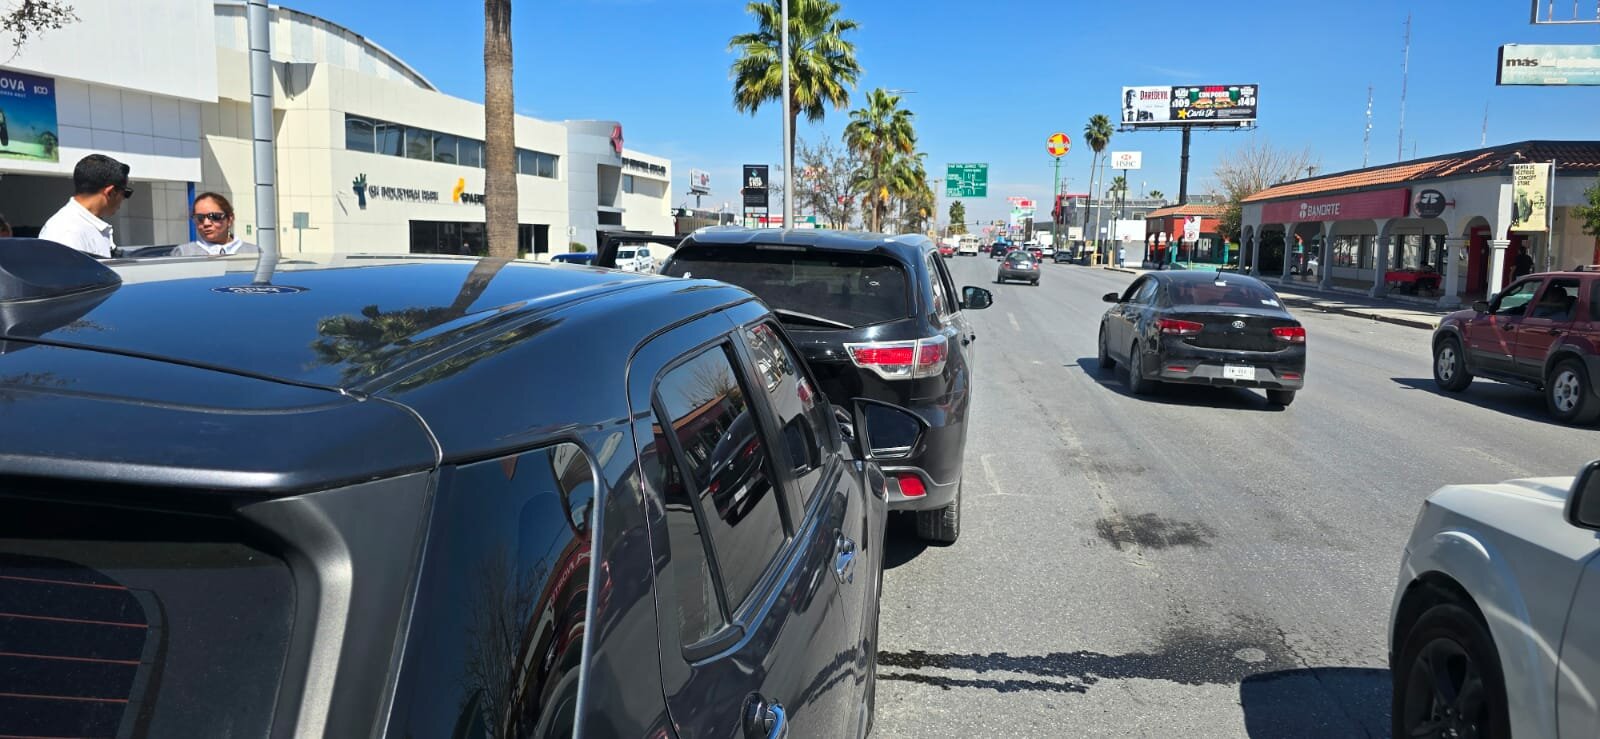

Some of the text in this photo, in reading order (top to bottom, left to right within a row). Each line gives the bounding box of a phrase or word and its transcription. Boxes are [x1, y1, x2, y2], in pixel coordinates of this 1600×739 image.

[0, 77, 25, 91] OVA
[1172, 98, 1190, 108] $109
[1237, 97, 1256, 106] $149
[1115, 160, 1137, 168] HSBC
[1307, 202, 1340, 217] BANORTE
